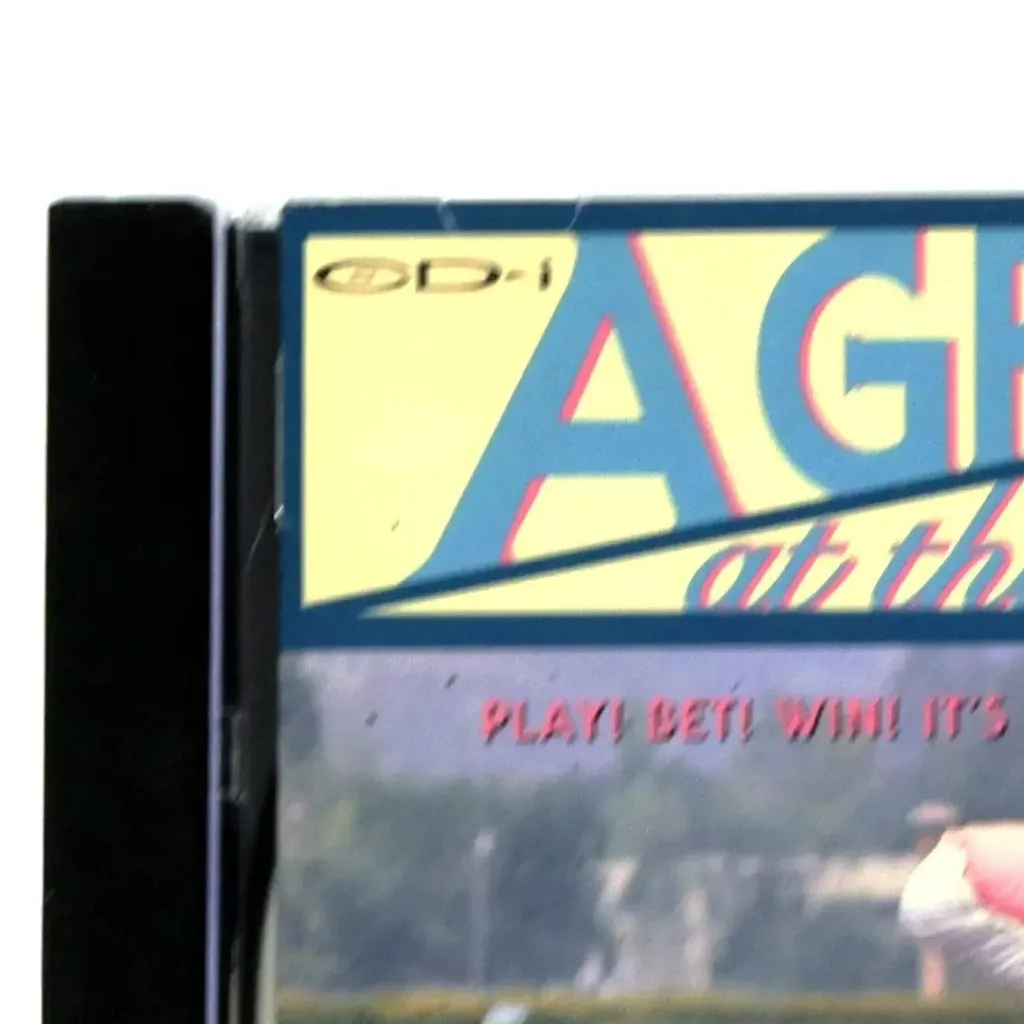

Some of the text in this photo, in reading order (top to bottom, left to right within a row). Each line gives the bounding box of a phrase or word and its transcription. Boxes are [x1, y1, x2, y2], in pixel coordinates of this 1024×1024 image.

[397, 231, 748, 586] A
[682, 517, 858, 613] at
[481, 695, 626, 745] PLAY!
[645, 694, 756, 743] BET!
[775, 694, 901, 743] WIN!
[921, 693, 1013, 742] IT'S
